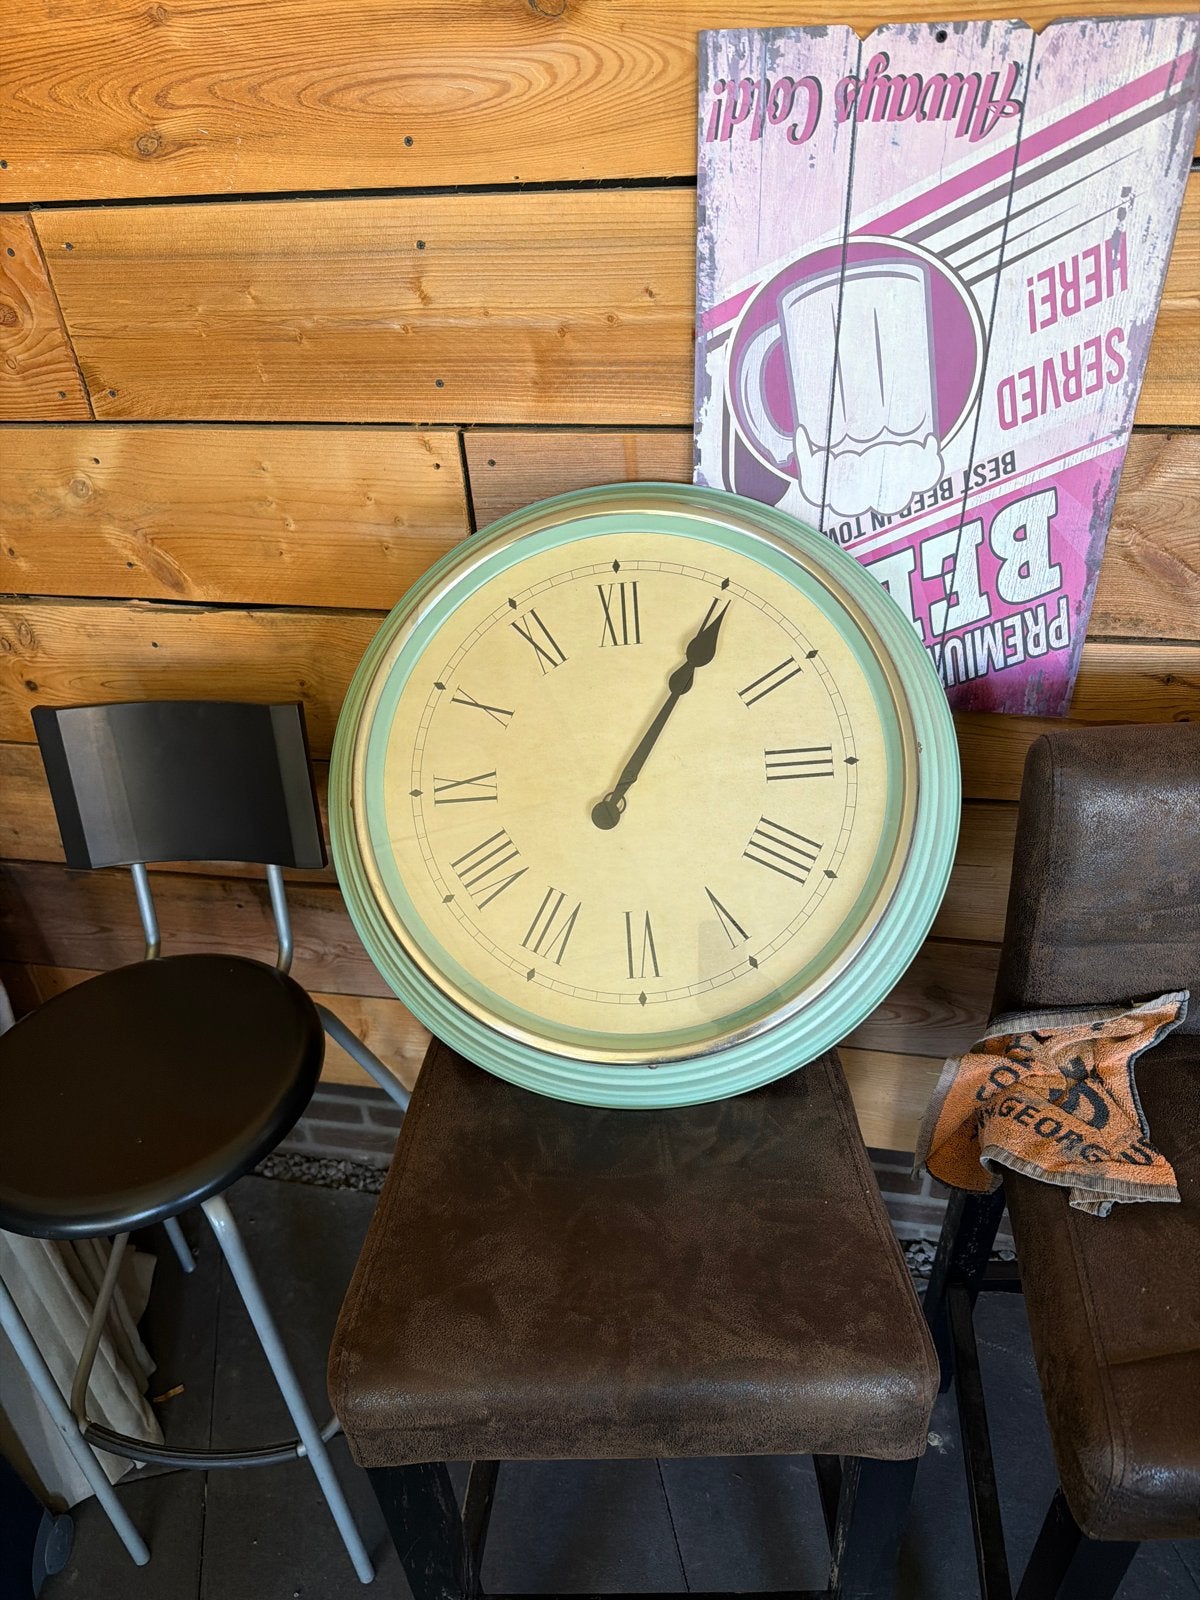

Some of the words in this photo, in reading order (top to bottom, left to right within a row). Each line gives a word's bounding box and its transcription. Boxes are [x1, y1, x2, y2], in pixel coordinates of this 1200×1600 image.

[706, 75, 823, 145] Cold!
[834, 51, 1025, 143] Always
[1026, 231, 1128, 334] HERE!
[996, 326, 1125, 430] SERVED
[960, 450, 1016, 494] BEST
[508, 607, 570, 676] XI
[594, 580, 644, 648] XII
[450, 685, 515, 729] X
[736, 654, 804, 709] II
[433, 768, 498, 806] IX
[764, 744, 834, 784] III
[449, 826, 529, 912] VIII
[741, 814, 825, 886] IIII
[519, 886, 581, 966] VII
[622, 909, 663, 979] VI
[704, 886, 752, 949] V
